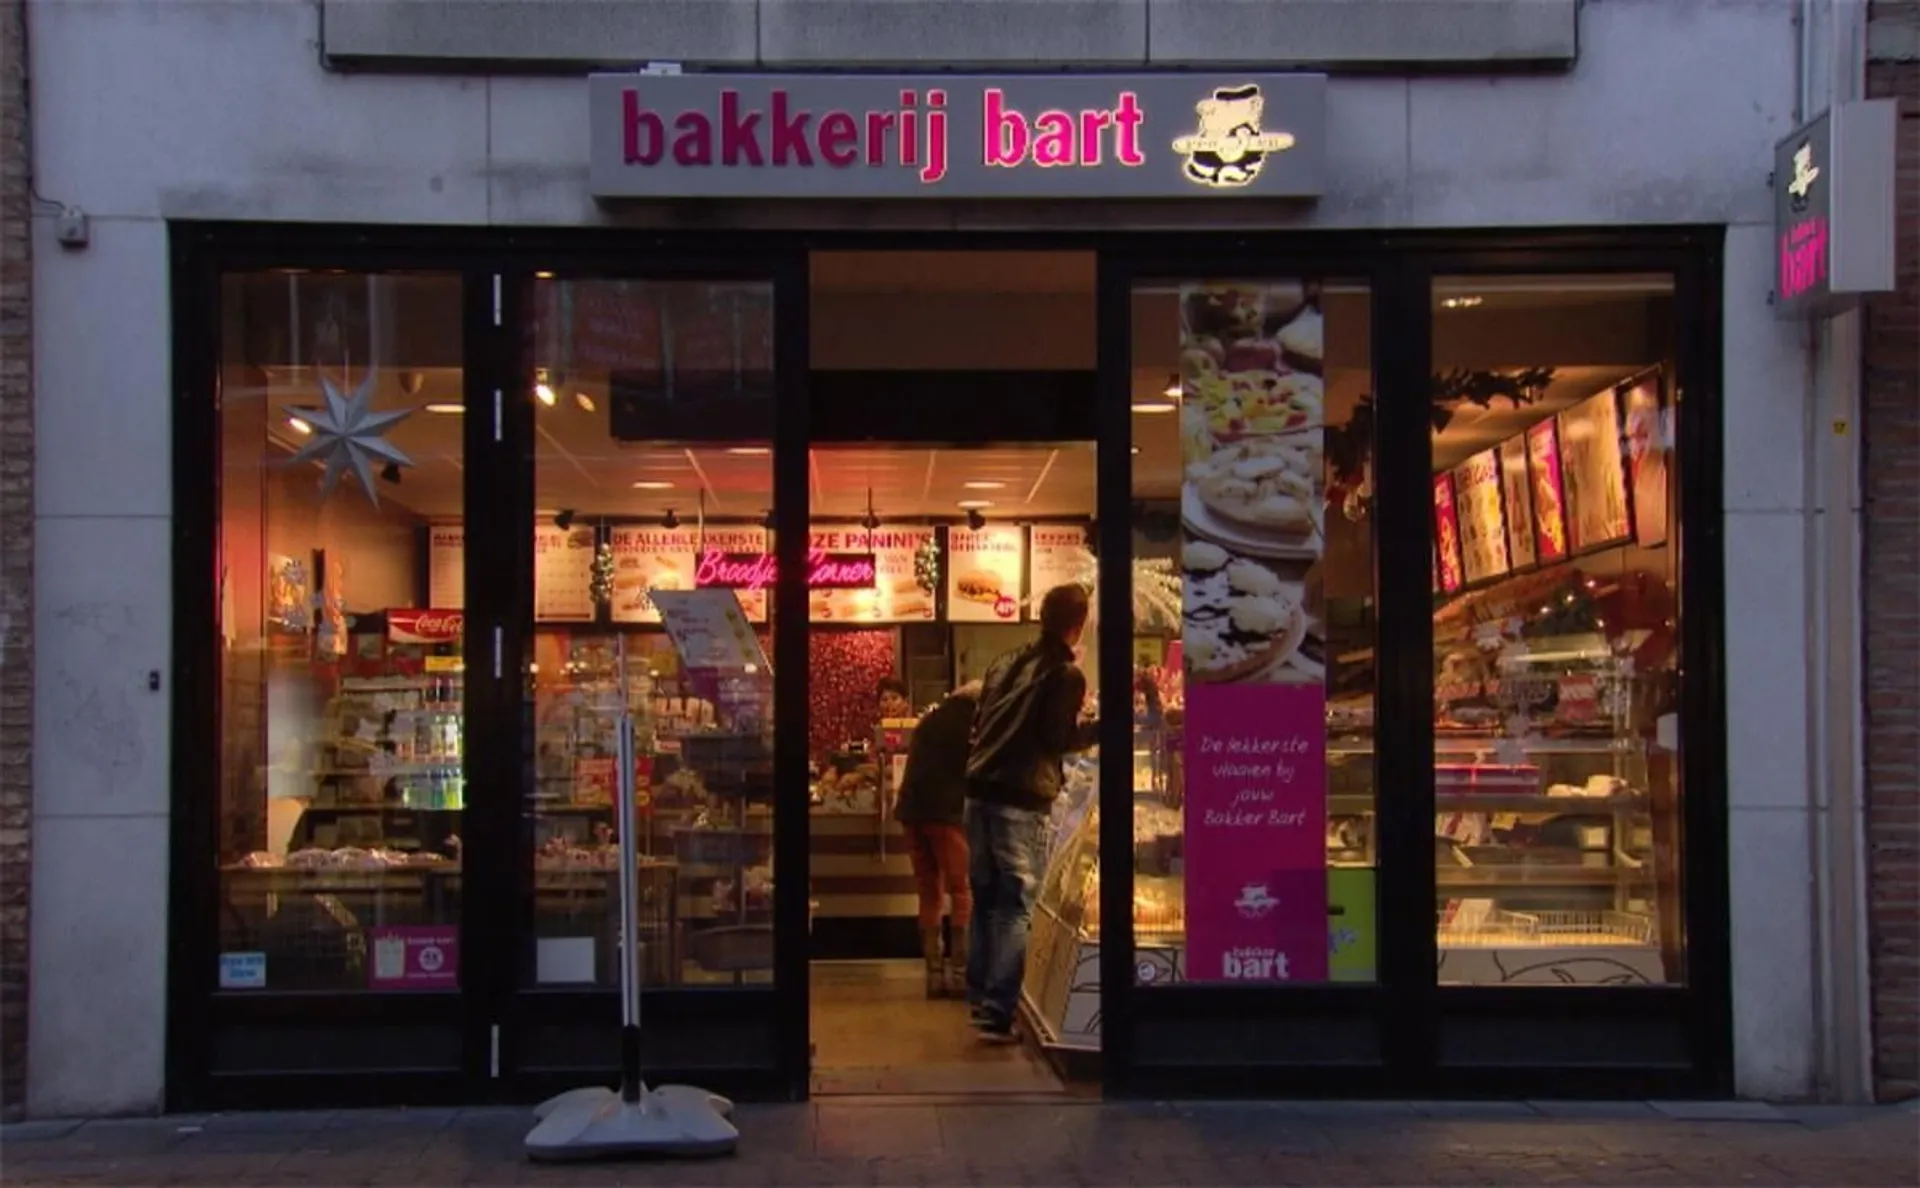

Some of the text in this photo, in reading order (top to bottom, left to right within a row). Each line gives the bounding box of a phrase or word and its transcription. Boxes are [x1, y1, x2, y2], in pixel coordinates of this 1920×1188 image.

[621, 88, 1145, 182] bakkerij bart
[1267, 807, 1307, 826] Bart
[1222, 951, 1290, 979] bart
